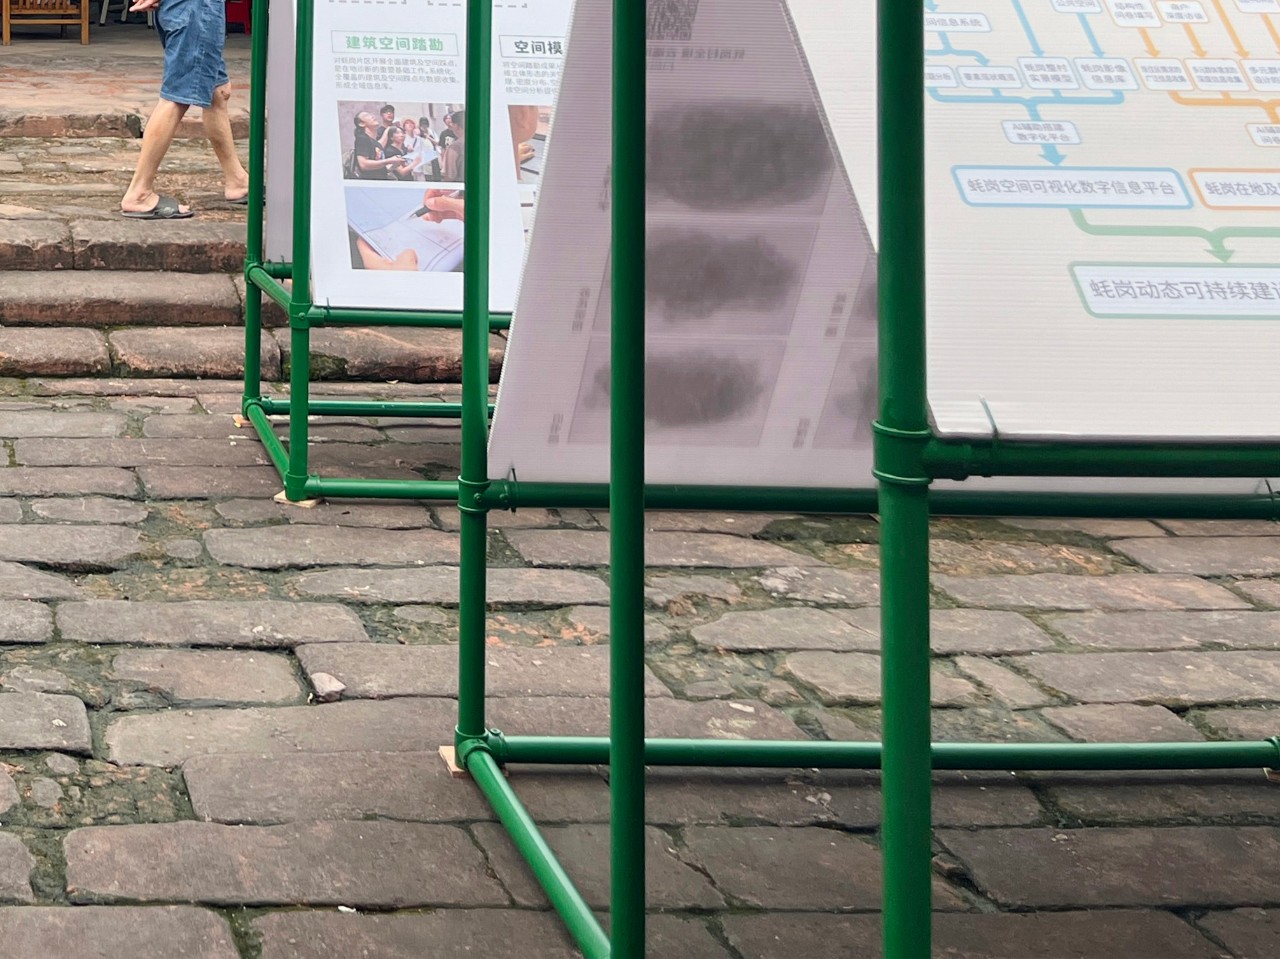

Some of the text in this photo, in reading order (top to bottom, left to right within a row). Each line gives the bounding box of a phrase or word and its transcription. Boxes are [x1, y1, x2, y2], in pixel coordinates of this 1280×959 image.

[345, 35, 444, 52] 建筑空间踏勘
[966, 178, 1176, 196] 蚝岗空间可视化数字信息平台
